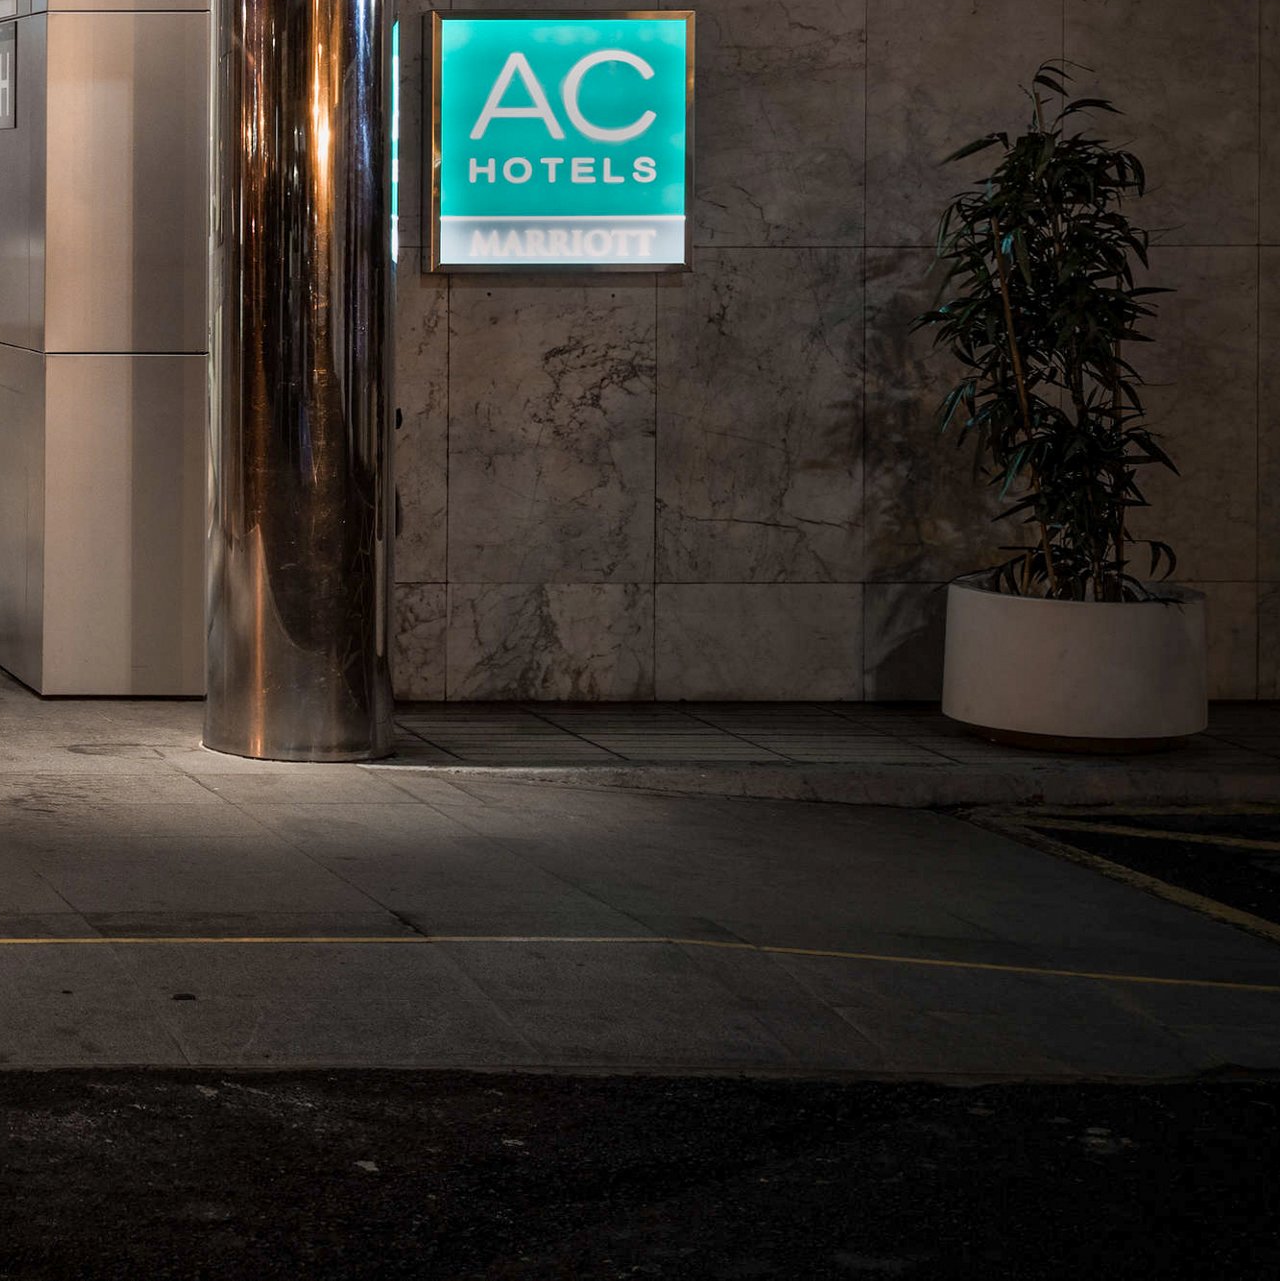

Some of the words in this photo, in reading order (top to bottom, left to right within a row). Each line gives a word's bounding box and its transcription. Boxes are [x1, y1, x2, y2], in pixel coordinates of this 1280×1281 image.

[469, 48, 657, 143] AC
[468, 156, 658, 184] HOTELS
[469, 228, 657, 258] MARRIOTT
